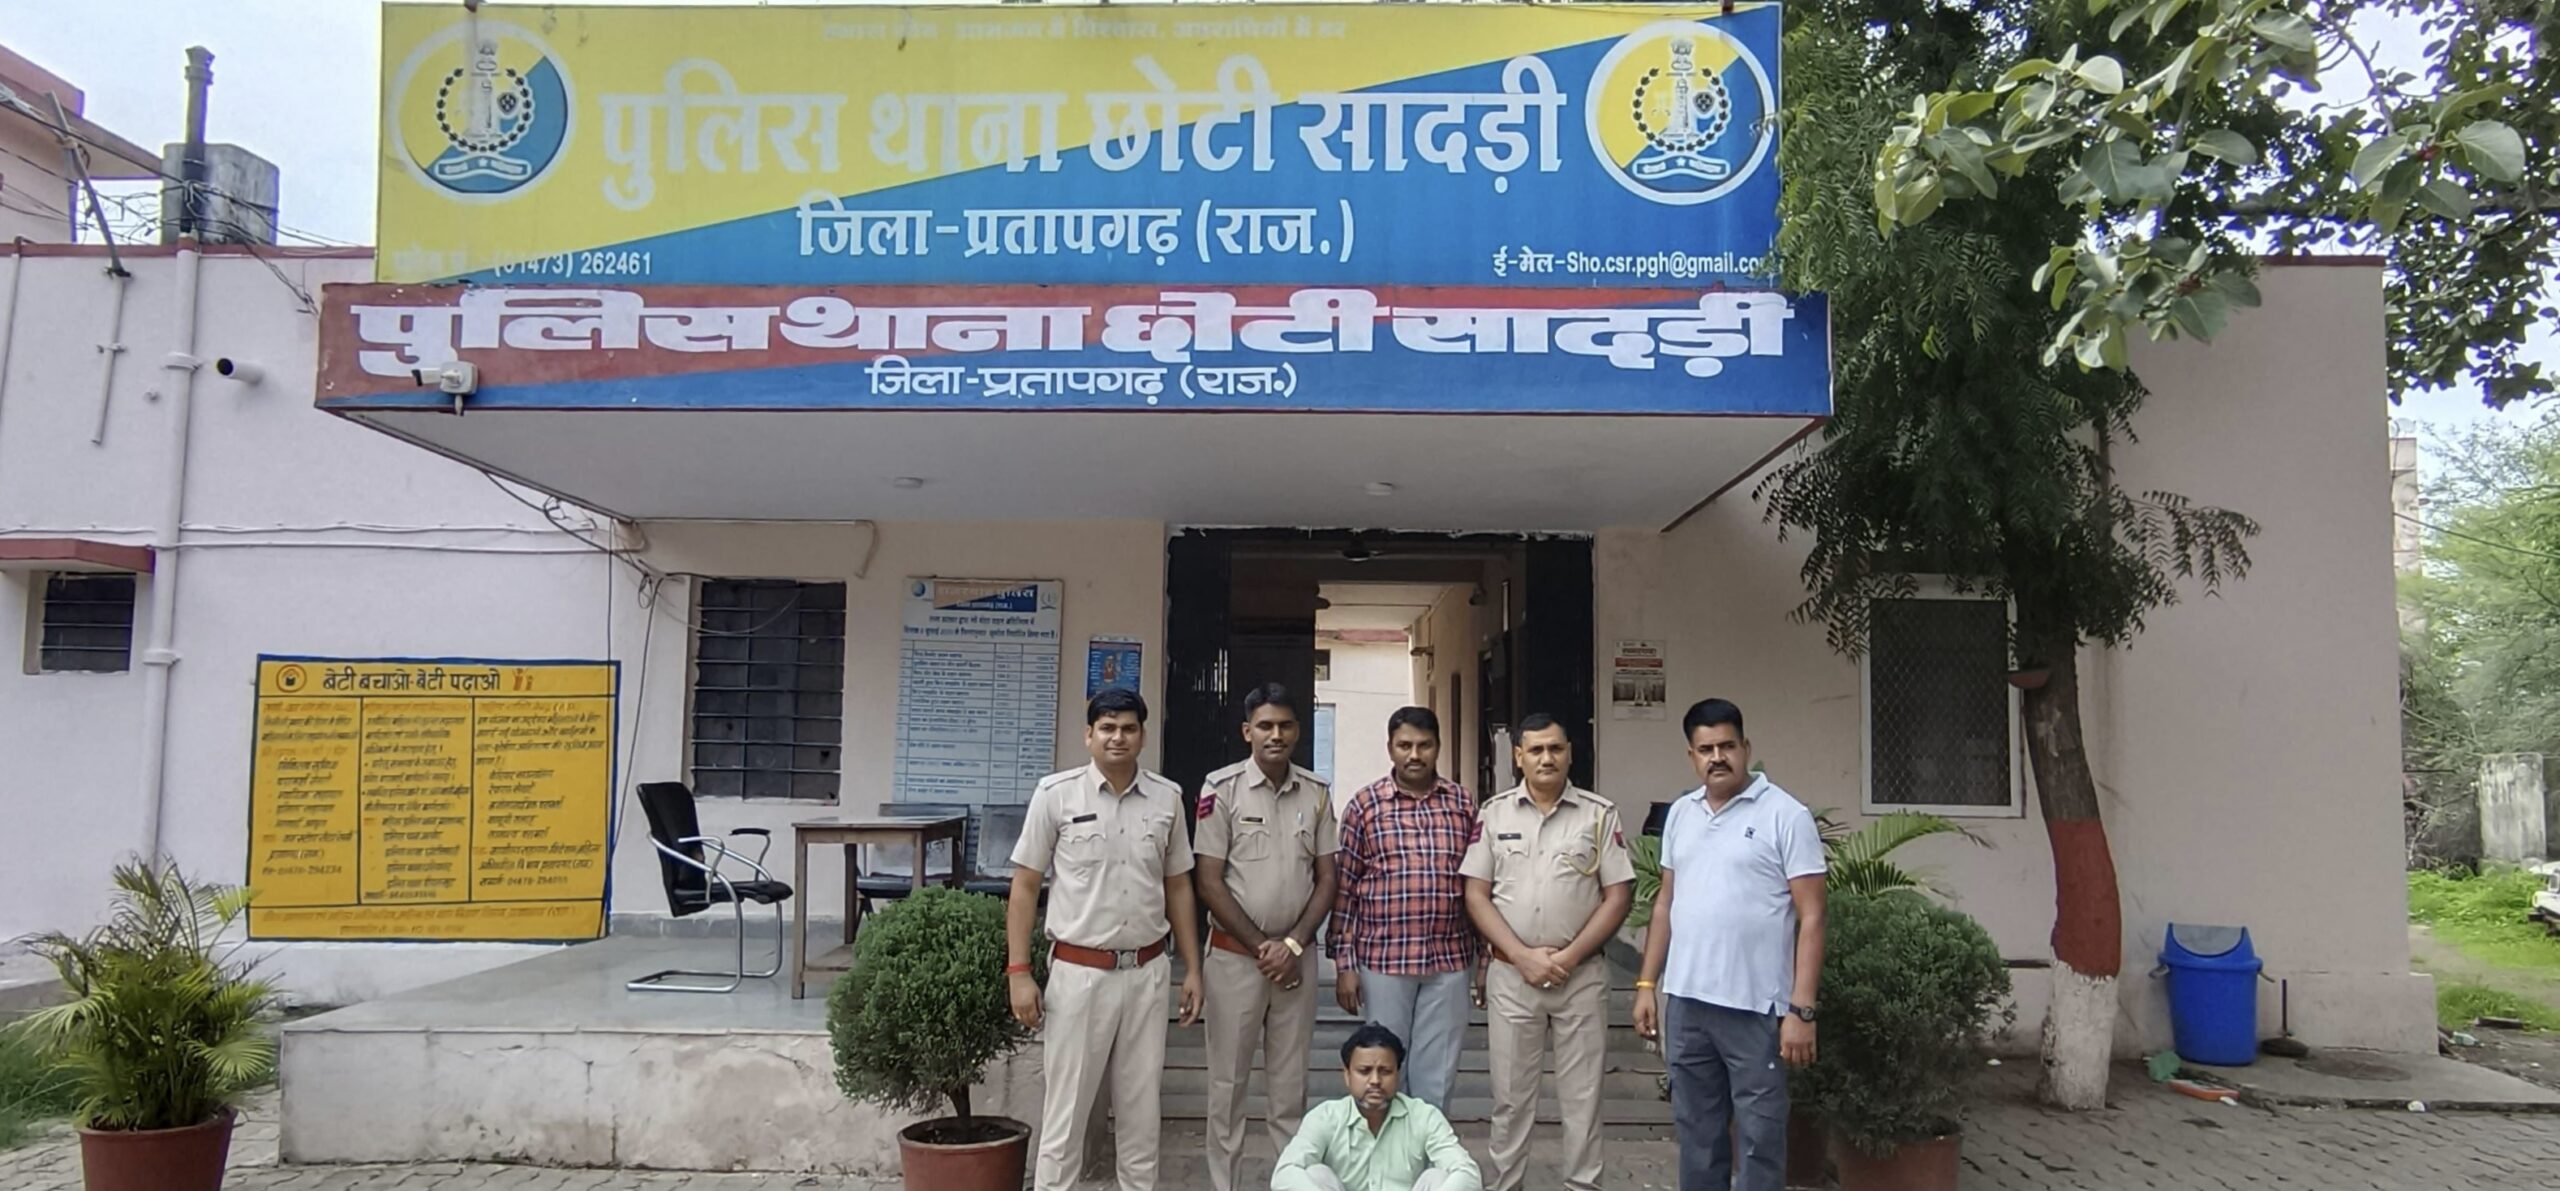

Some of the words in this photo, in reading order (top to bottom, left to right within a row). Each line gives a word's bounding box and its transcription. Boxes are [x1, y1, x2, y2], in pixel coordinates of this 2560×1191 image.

[600, 58, 849, 210] पुलिस
[869, 91, 1068, 173] थाना
[1085, 55, 1281, 173] छोटी
[1297, 55, 1568, 194] सादड़ी
[580, 251, 652, 275] 262461
[1196, 199, 1355, 263] (राज.)
[349, 290, 780, 379] पुलिस
[779, 295, 1093, 352] थाना
[1101, 289, 1390, 364] छोटी
[1391, 291, 1796, 378] सादड़ी
[323, 665, 357, 690] बेटी
